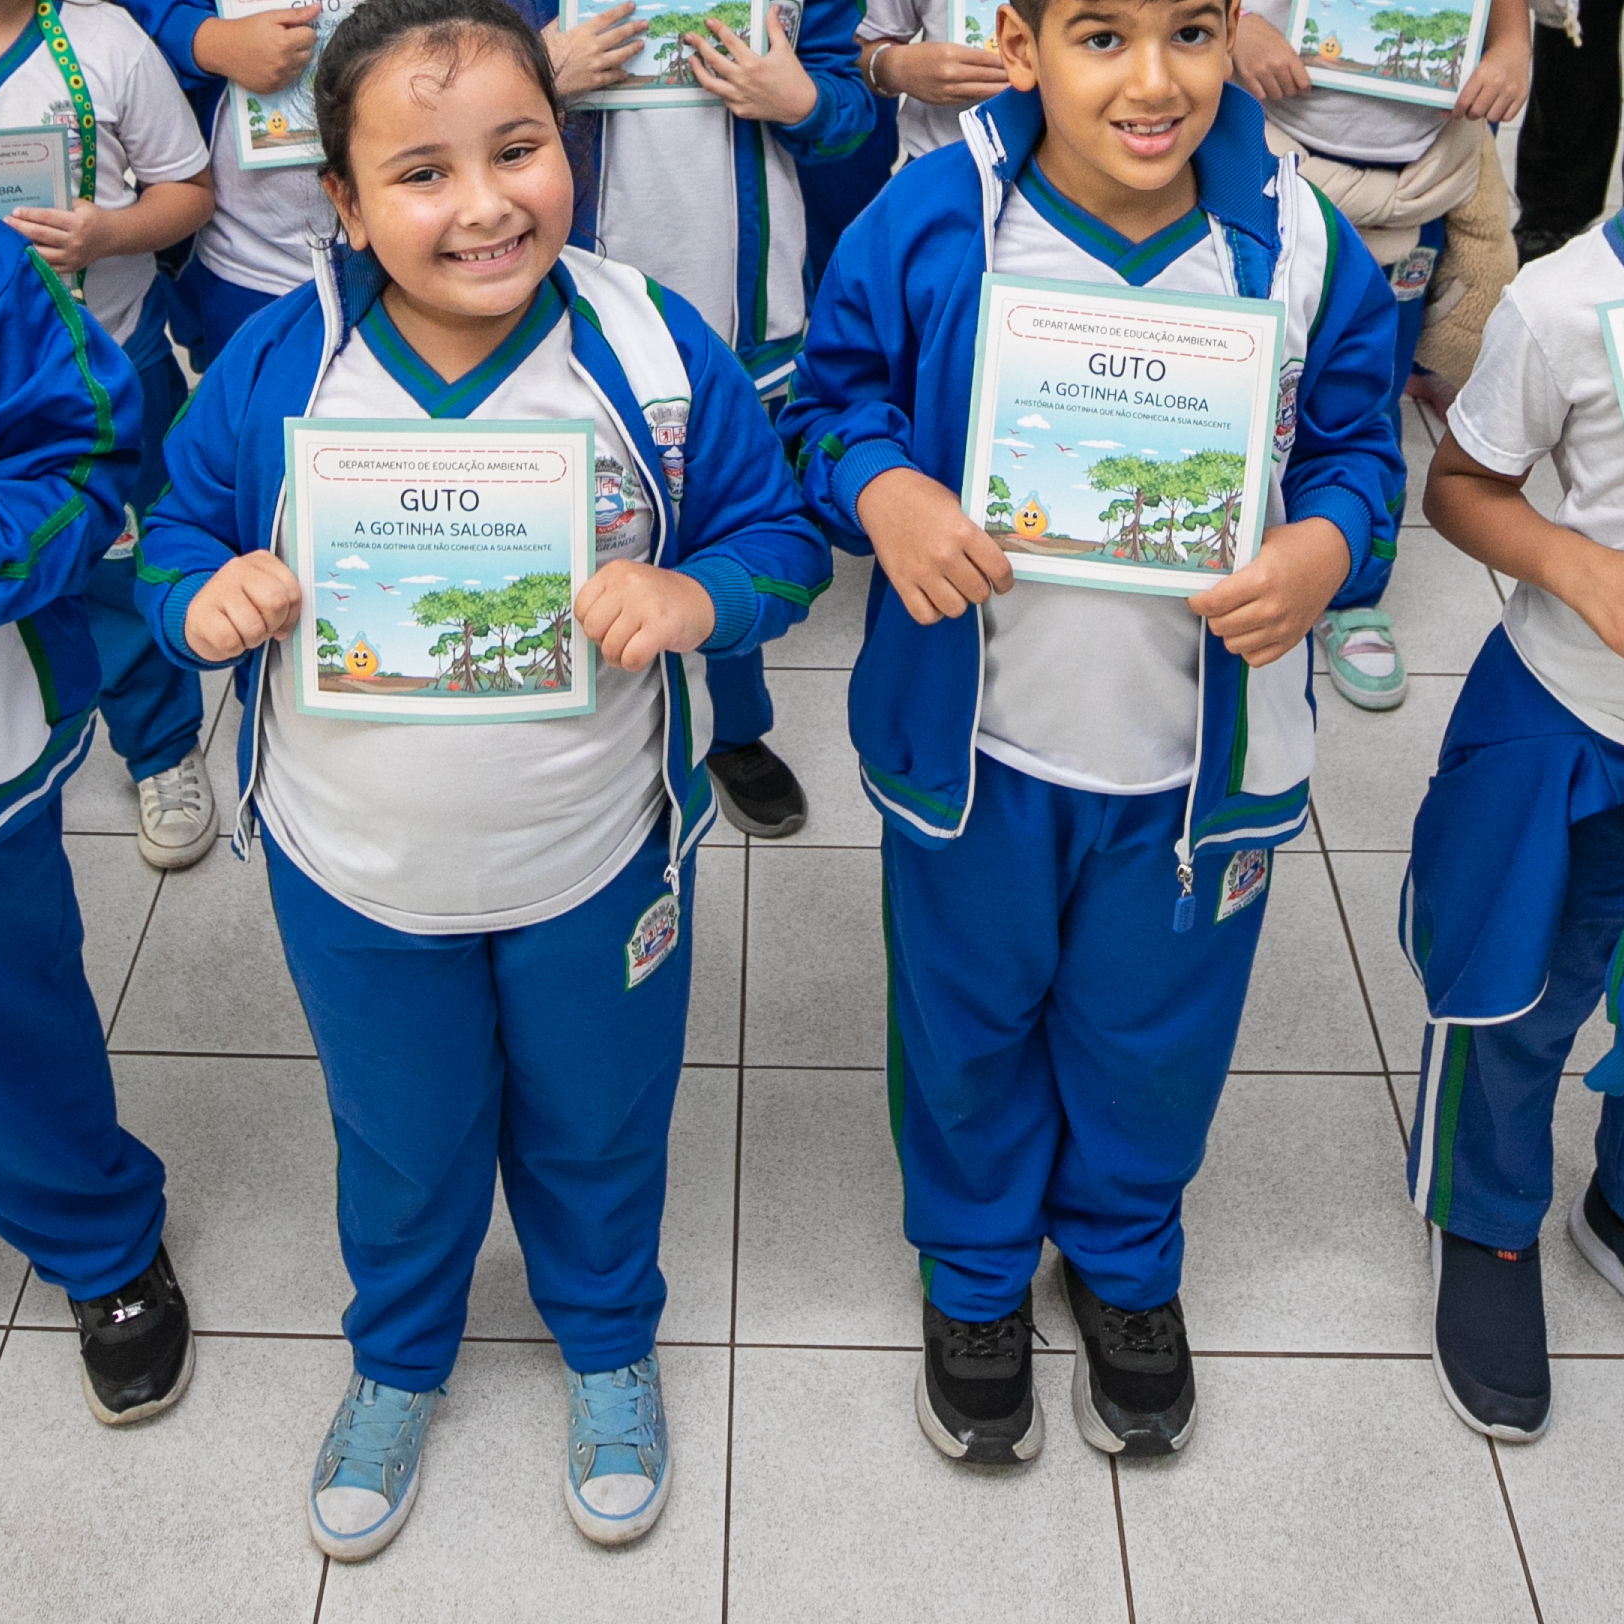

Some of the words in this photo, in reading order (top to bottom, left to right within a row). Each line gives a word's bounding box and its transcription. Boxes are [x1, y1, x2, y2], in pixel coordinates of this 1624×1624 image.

[1033, 319, 1107, 334] DEPARTAMENTO
[1109, 327, 1121, 336] DE
[1124, 329, 1175, 342] EDUCAÇÃO
[1177, 335, 1227, 349] AMBIENTAL
[1089, 353, 1166, 381] GUTO
[1040, 380, 1050, 394] A
[1056, 382, 1128, 402] GOTINHA
[1134, 391, 1208, 411] SALOBRA
[1021, 399, 1054, 408] HISTÓRIA
[1066, 405, 1098, 414] GOTINHA
[1099, 408, 1114, 416] QUE
[1115, 409, 1131, 418] NÃO
[1132, 412, 1169, 422] CONHECIA
[1177, 417, 1192, 425] SUA
[1193, 419, 1231, 429] NASCENTE
[339, 460, 415, 470] DEPARTAMENTO
[417, 461, 430, 470] DE
[432, 460, 485, 472] EDUCAÇÃO
[487, 462, 539, 471] AMBIENTAL
[401, 489, 479, 512] GUTO
[354, 521, 365, 534] A
[371, 522, 444, 535] GOTINHA
[451, 523, 527, 537] SALOBRA
[337, 541, 370, 549] HISTÓRIA
[433, 542, 450, 551] NÃO
